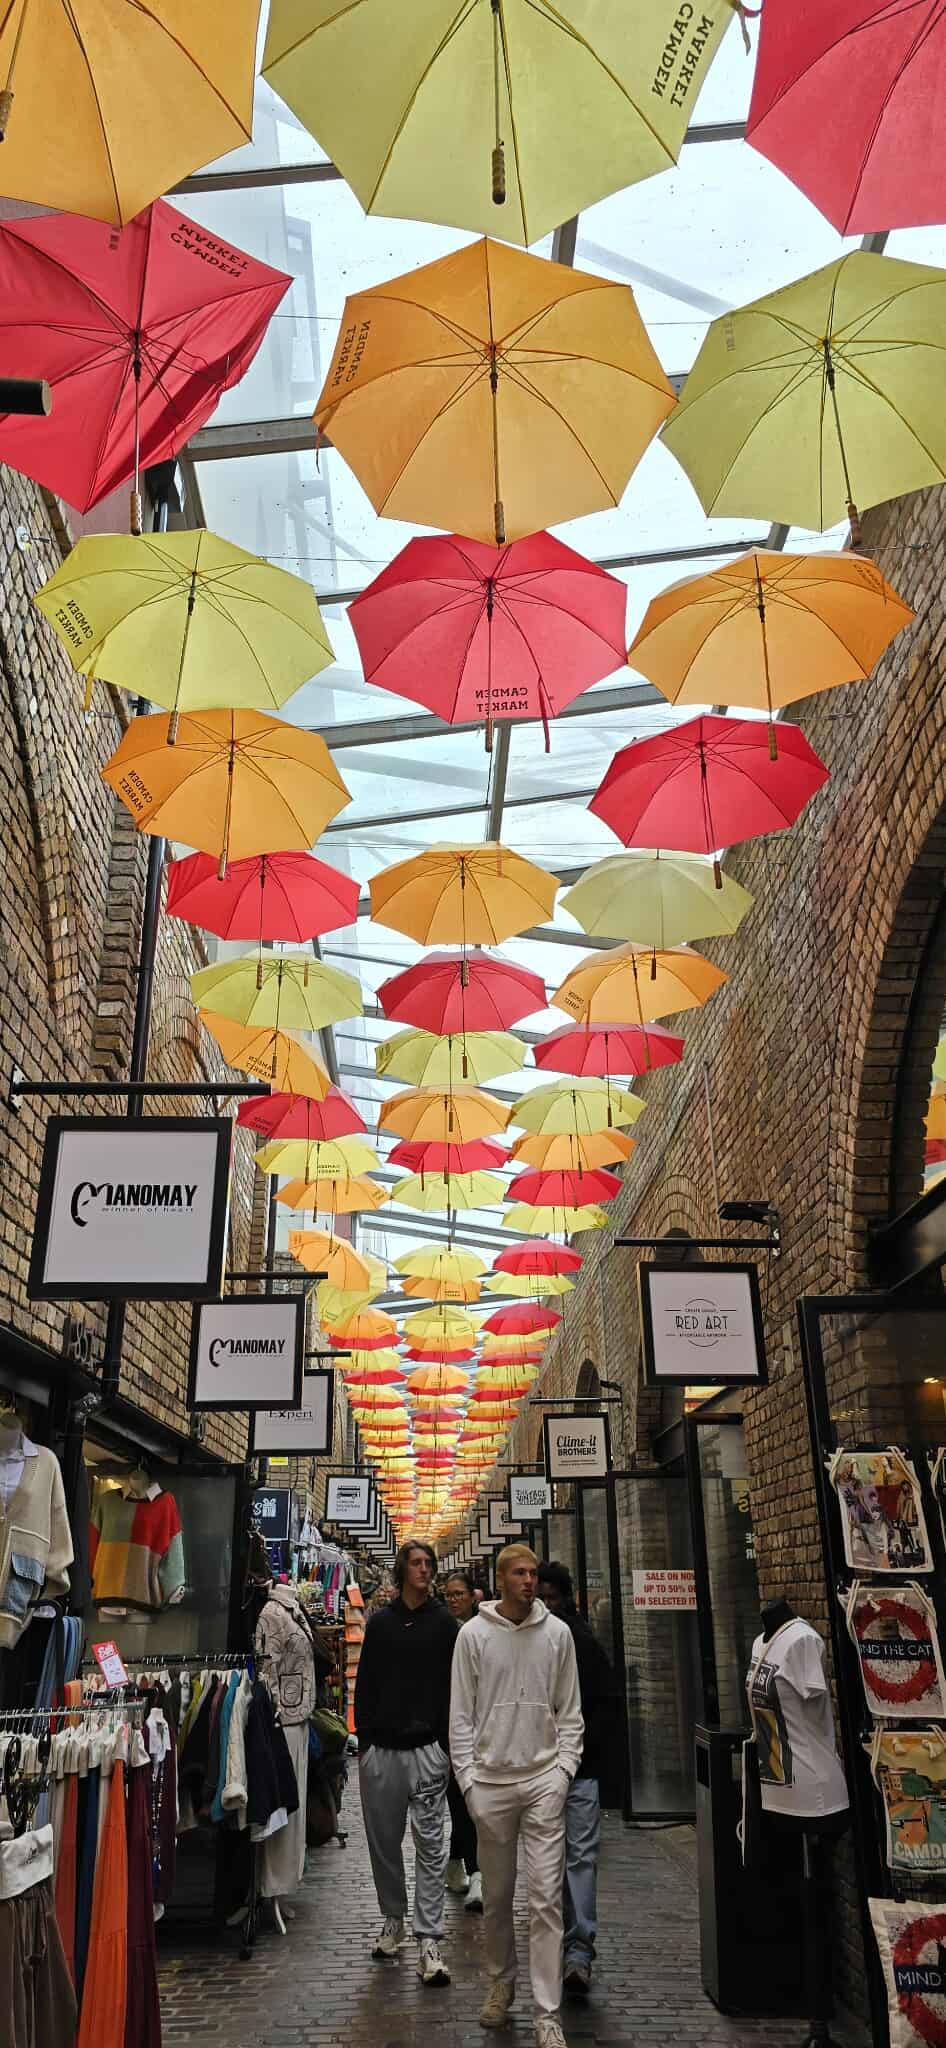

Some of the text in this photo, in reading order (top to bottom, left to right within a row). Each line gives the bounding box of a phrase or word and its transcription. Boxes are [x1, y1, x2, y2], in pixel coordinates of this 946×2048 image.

[71, 1182, 197, 1227] MANOMAY
[675, 1315, 728, 1330] RED ART
[209, 1338, 285, 1367] MANOMAY
[557, 1447, 597, 1457] BROTHERS
[646, 1572, 665, 1580] SALE
[667, 1572, 679, 1580] ON
[643, 1584, 655, 1592] UP
[656, 1584, 666, 1592] TO
[668, 1584, 686, 1592] 50%
[635, 1597, 646, 1605] ON
[648, 1597, 687, 1605] SELECTED
[882, 1644, 905, 1656] THE
[907, 1644, 932, 1656] CAT
[897, 1971, 941, 1987] MIND
